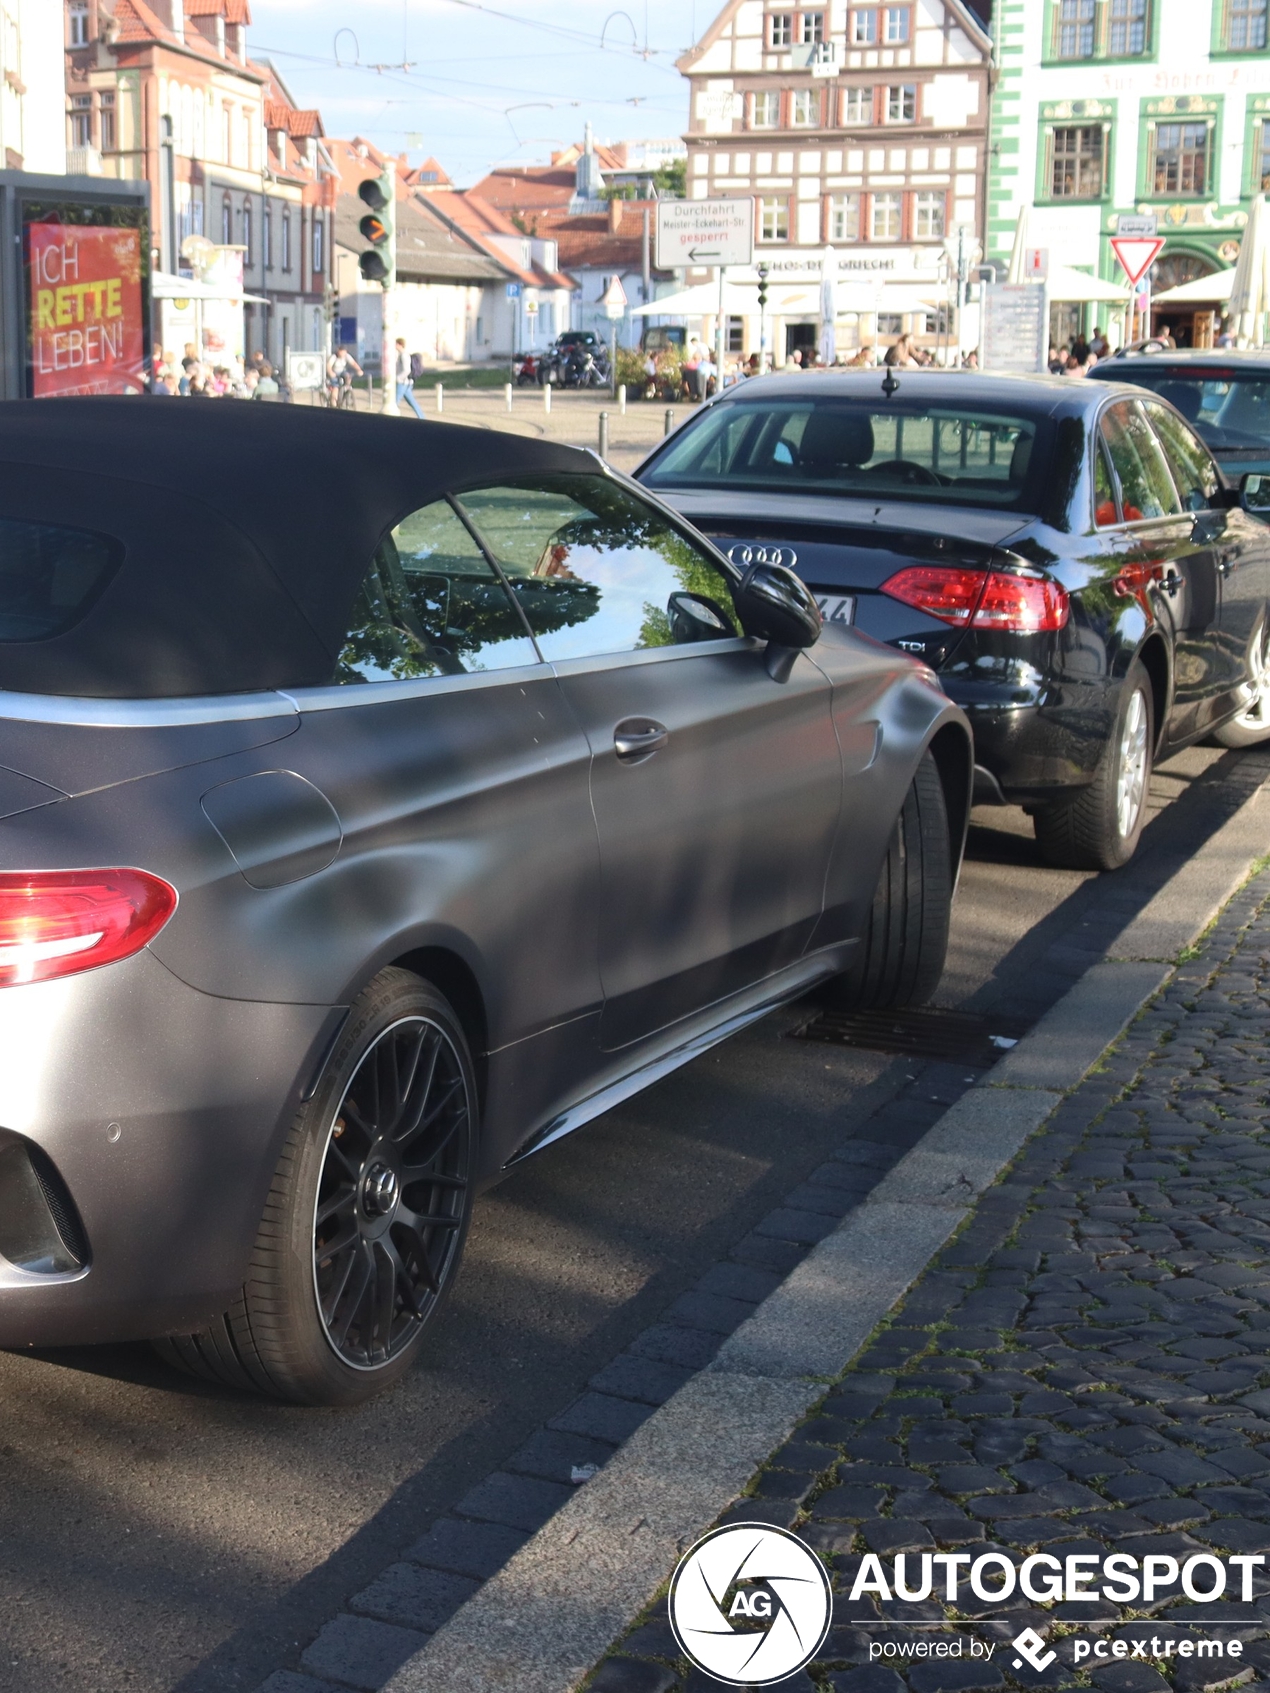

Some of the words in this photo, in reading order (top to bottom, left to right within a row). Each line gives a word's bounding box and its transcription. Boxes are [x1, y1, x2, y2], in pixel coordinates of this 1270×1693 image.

[674, 204, 735, 217] Durchfahrt
[680, 231, 729, 246] gesperrt
[35, 242, 79, 285] ICH
[37, 277, 123, 329] RETTE
[39, 320, 123, 374] LEBEN!
[898, 640, 926, 652] TDI
